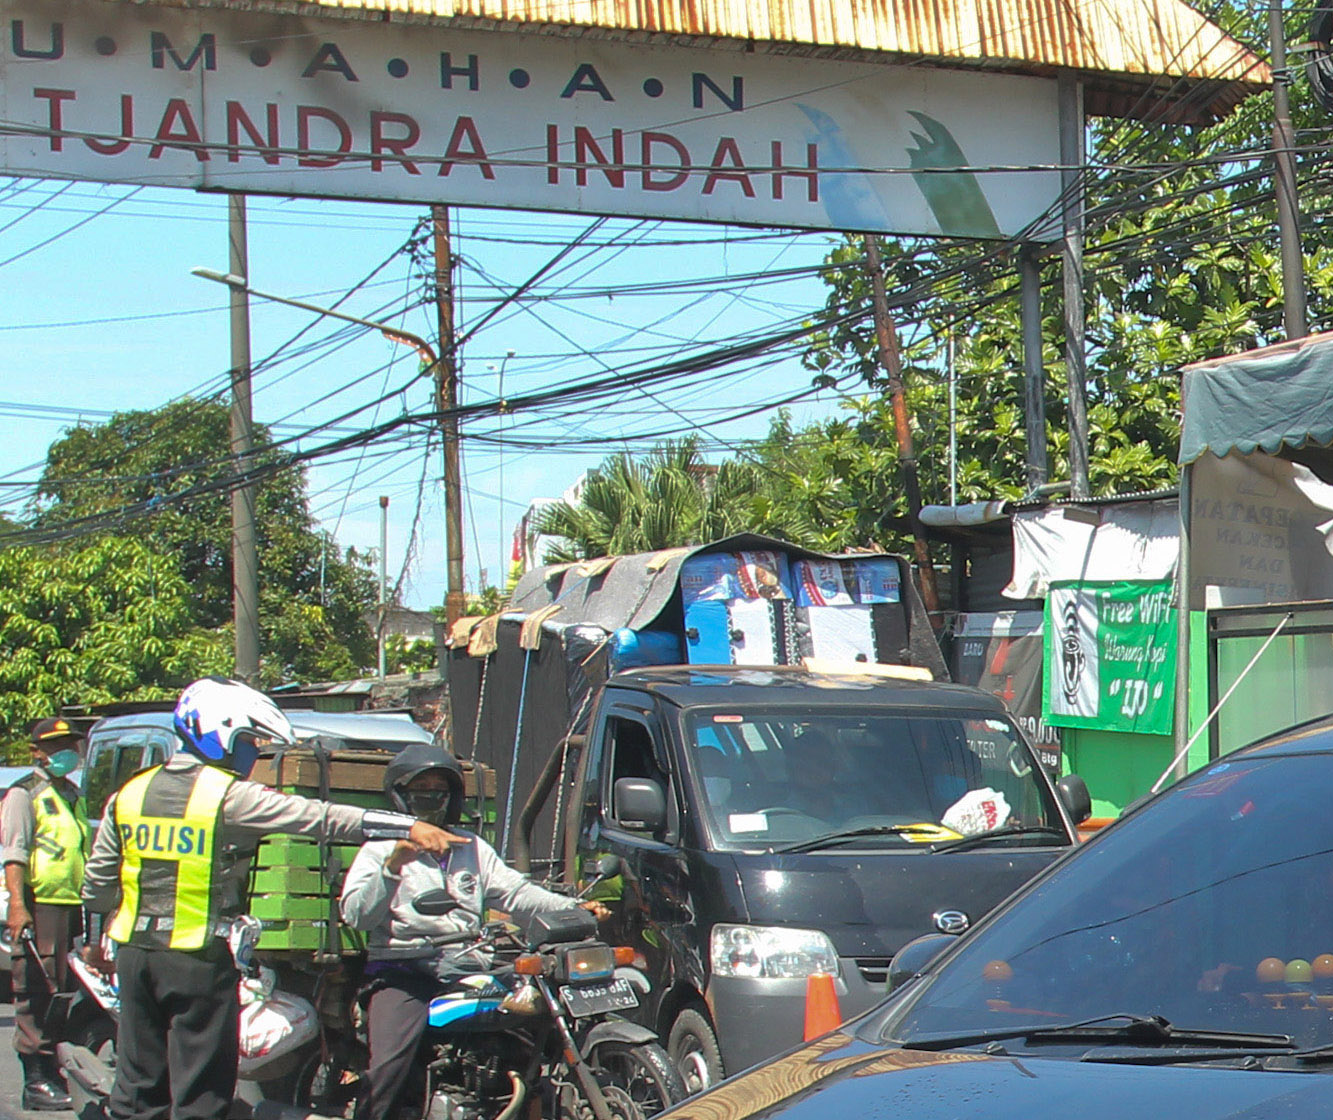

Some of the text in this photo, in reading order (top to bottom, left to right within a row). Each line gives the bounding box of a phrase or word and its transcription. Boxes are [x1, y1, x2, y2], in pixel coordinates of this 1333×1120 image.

[33, 87, 819, 203] TJANDRA INDAH
[1102, 590, 1172, 624] Free WiFi
[120, 823, 206, 855] POLISI
